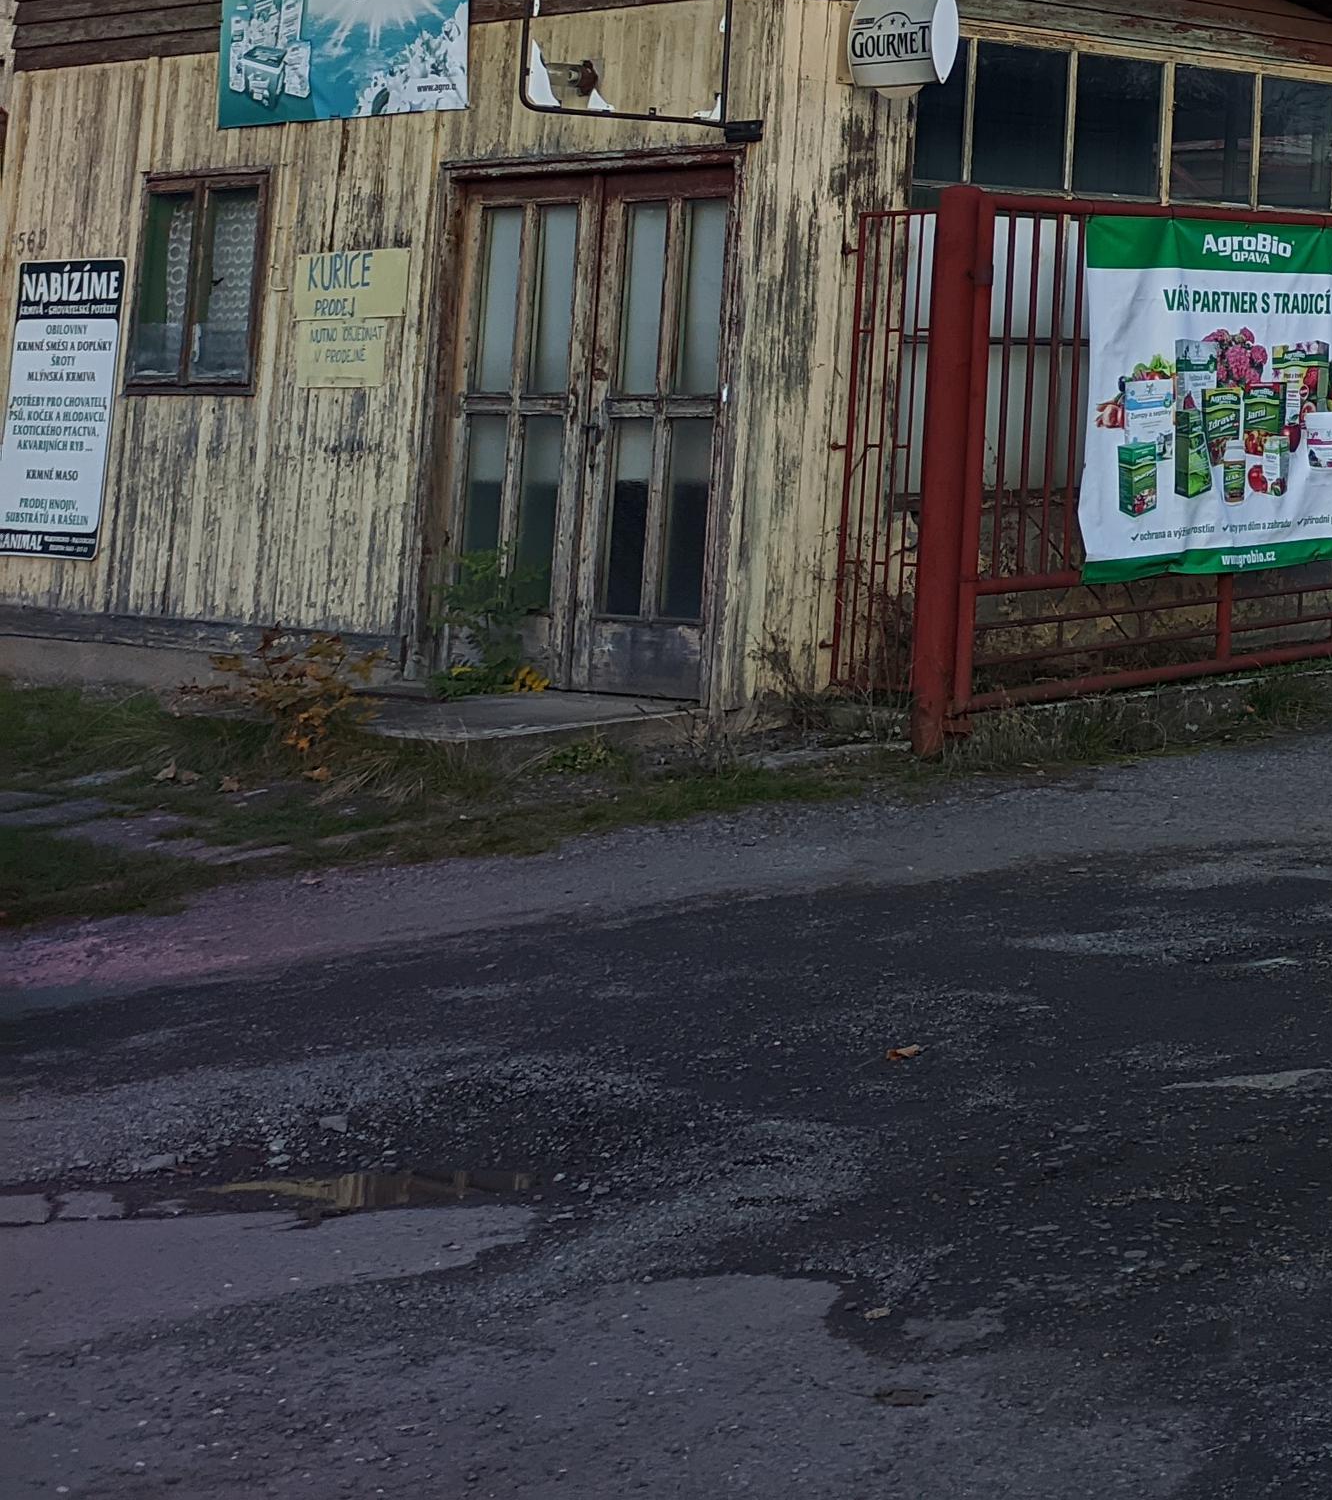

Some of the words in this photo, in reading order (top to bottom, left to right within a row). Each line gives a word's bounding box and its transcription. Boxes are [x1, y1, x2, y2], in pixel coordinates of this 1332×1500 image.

[1201, 233, 1292, 259] AgroBio
[1231, 250, 1271, 265] OPAVA
[21, 263, 120, 304] NABÍZÍME
[1162, 283, 1190, 312] VÁŠ
[1192, 289, 1258, 314] PARTNER
[1261, 295, 1271, 314] S
[1273, 288, 1332, 315] TRADICÍ
[313, 296, 356, 318] PRODEJ
[46, 324, 88, 335] OBILOVINY
[70, 341, 76, 351] A
[50, 355, 77, 367] ŠROTY
[65, 372, 96, 382] KRMIVA
[46, 397, 63, 408] PRO
[55, 411, 61, 422] A
[12, 423, 62, 436] EXOTICKÉHO
[26, 467, 53, 481] KRMNÉ
[55, 469, 79, 481] MASO
[19, 498, 48, 512] PRODEJ
[50, 513, 56, 524] A
[57, 513, 89, 526] RAŠELIN
[1139, 529, 1166, 541] ochrana
